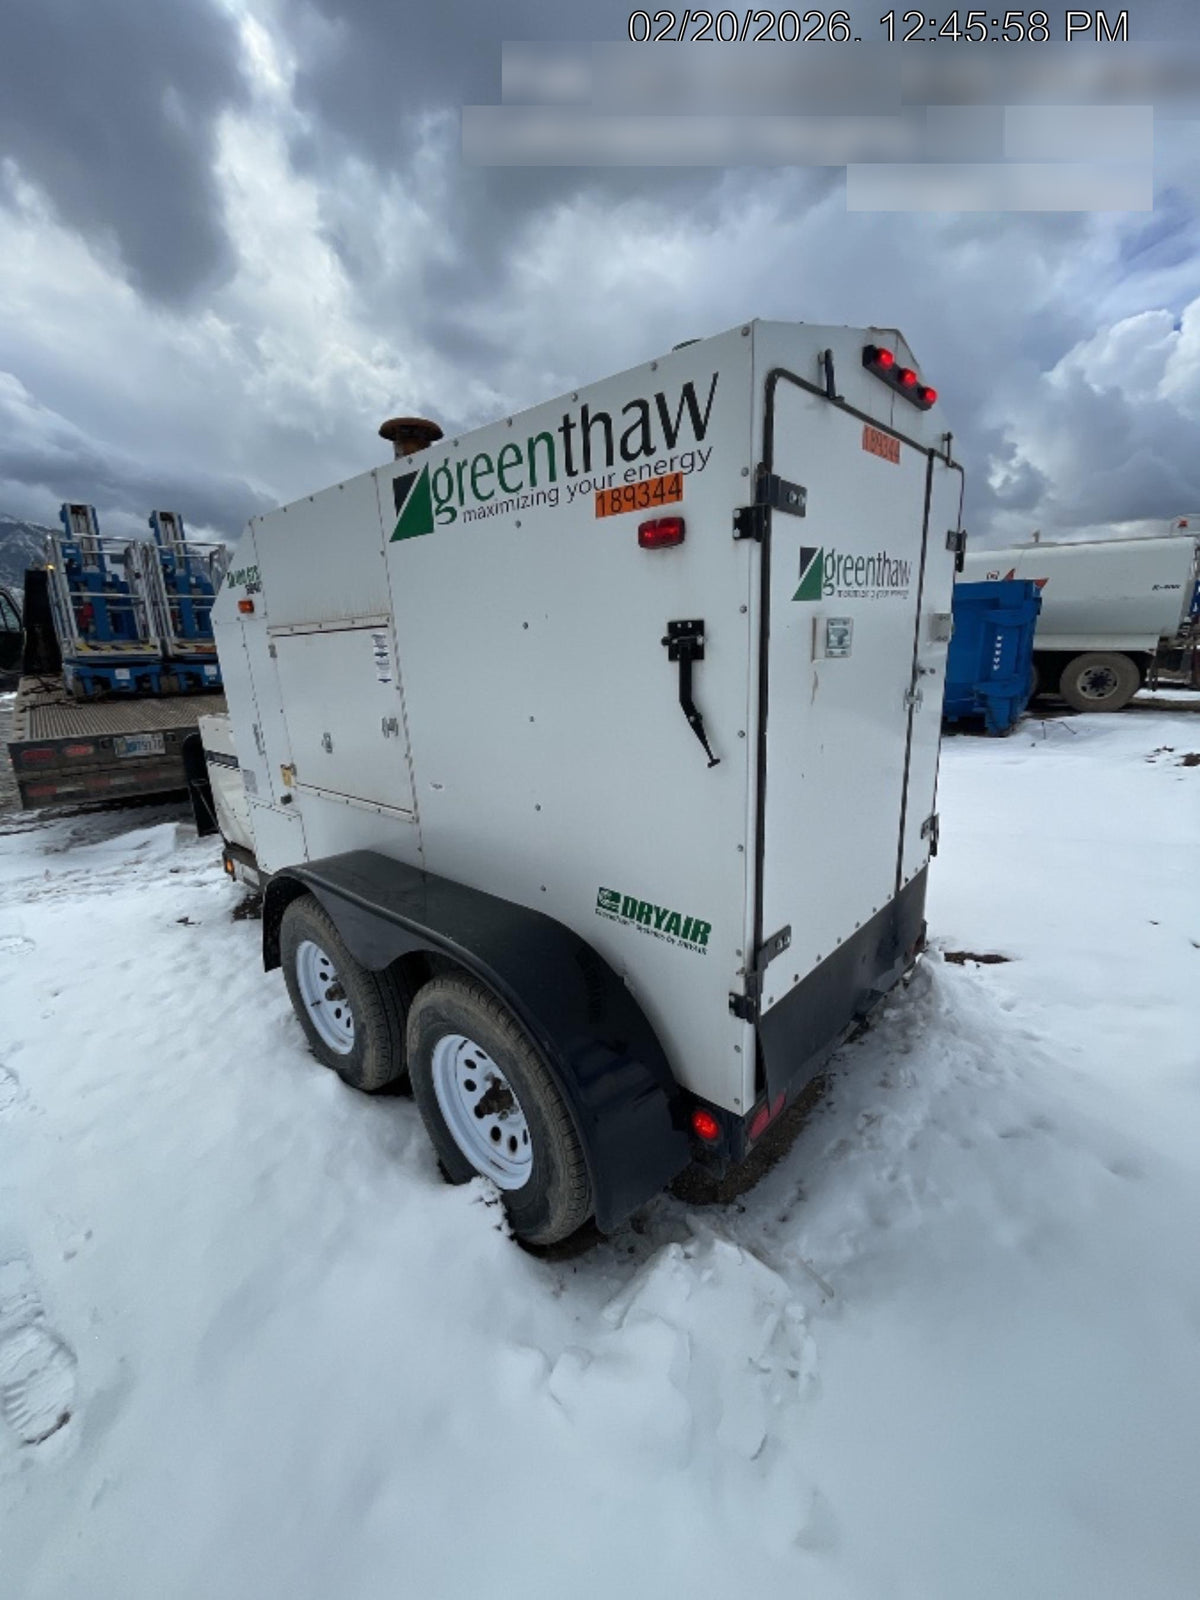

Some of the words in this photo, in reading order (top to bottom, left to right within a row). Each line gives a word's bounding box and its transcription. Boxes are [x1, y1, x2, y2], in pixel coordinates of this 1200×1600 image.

[431, 371, 719, 525] greenthaw
[463, 486, 560, 523] maximizing
[566, 471, 616, 503] your
[623, 446, 713, 483] energy
[595, 473, 682, 517] 189344
[823, 548, 912, 596] greenthaw
[621, 895, 712, 946] DRYAIR
